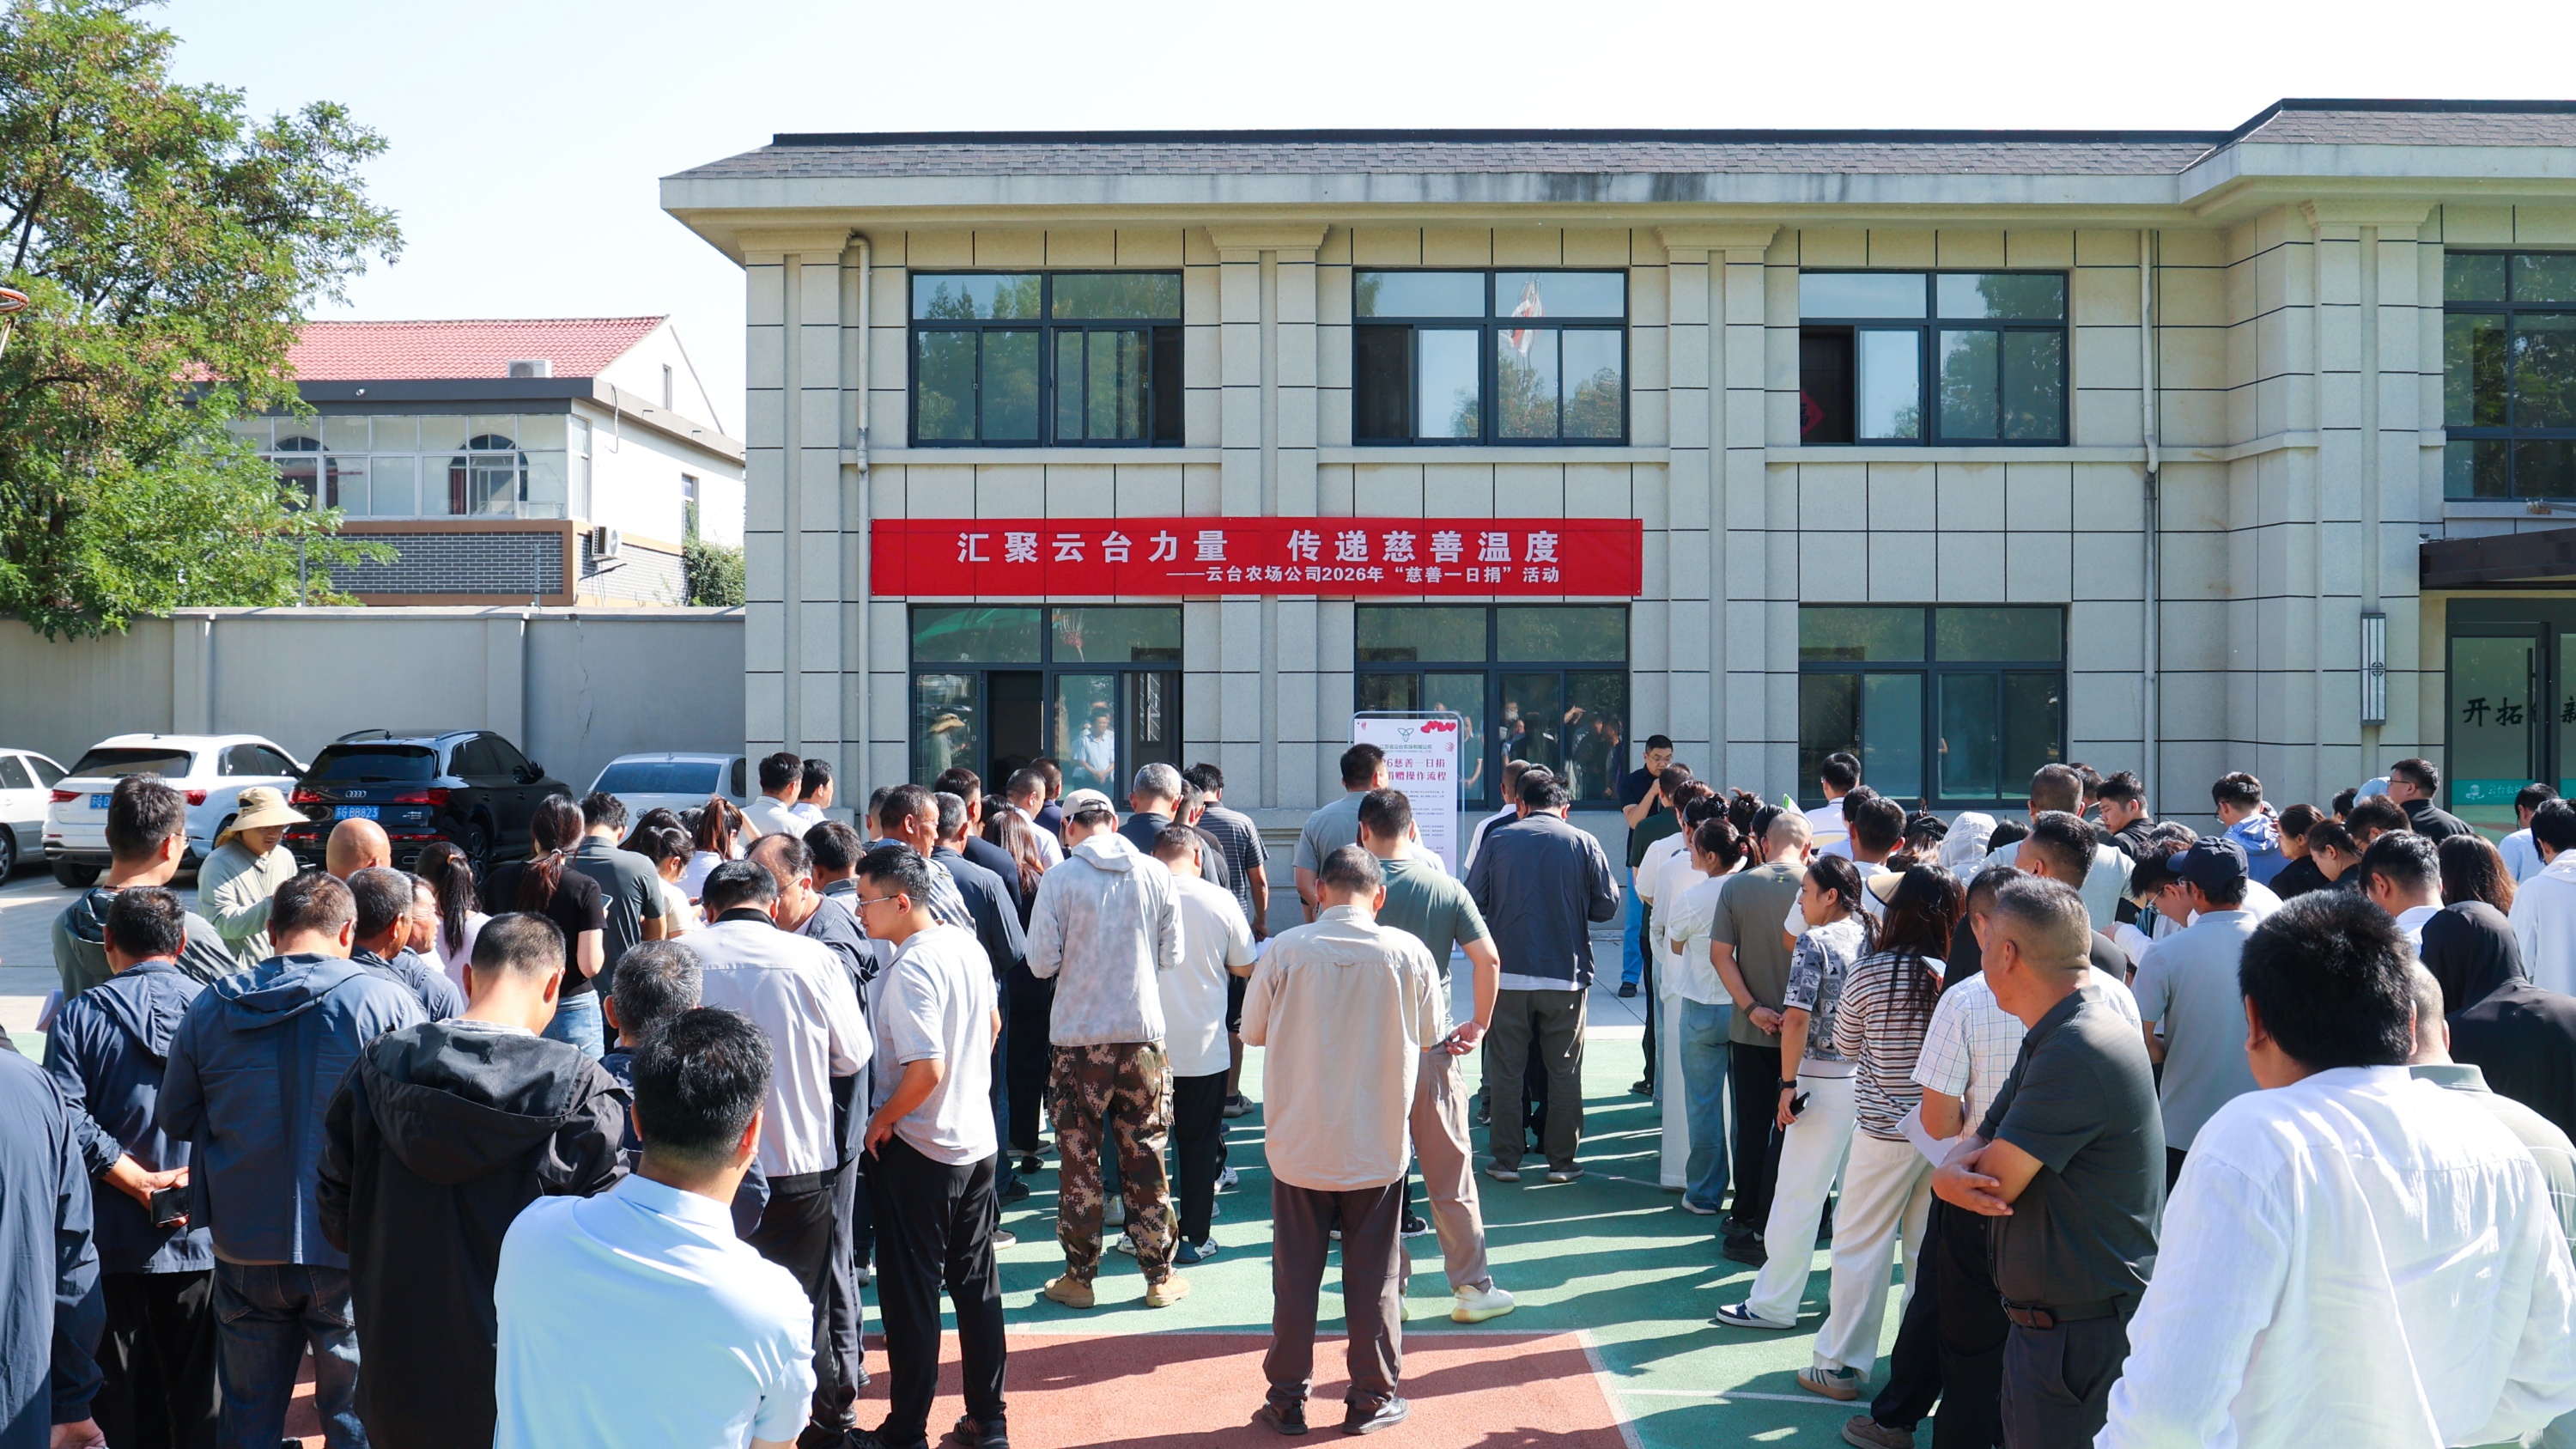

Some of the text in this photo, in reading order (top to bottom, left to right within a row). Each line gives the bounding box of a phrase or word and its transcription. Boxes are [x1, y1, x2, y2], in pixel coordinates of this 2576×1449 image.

[957, 529, 1558, 563] 汇聚云台力量 传递慈善温度
